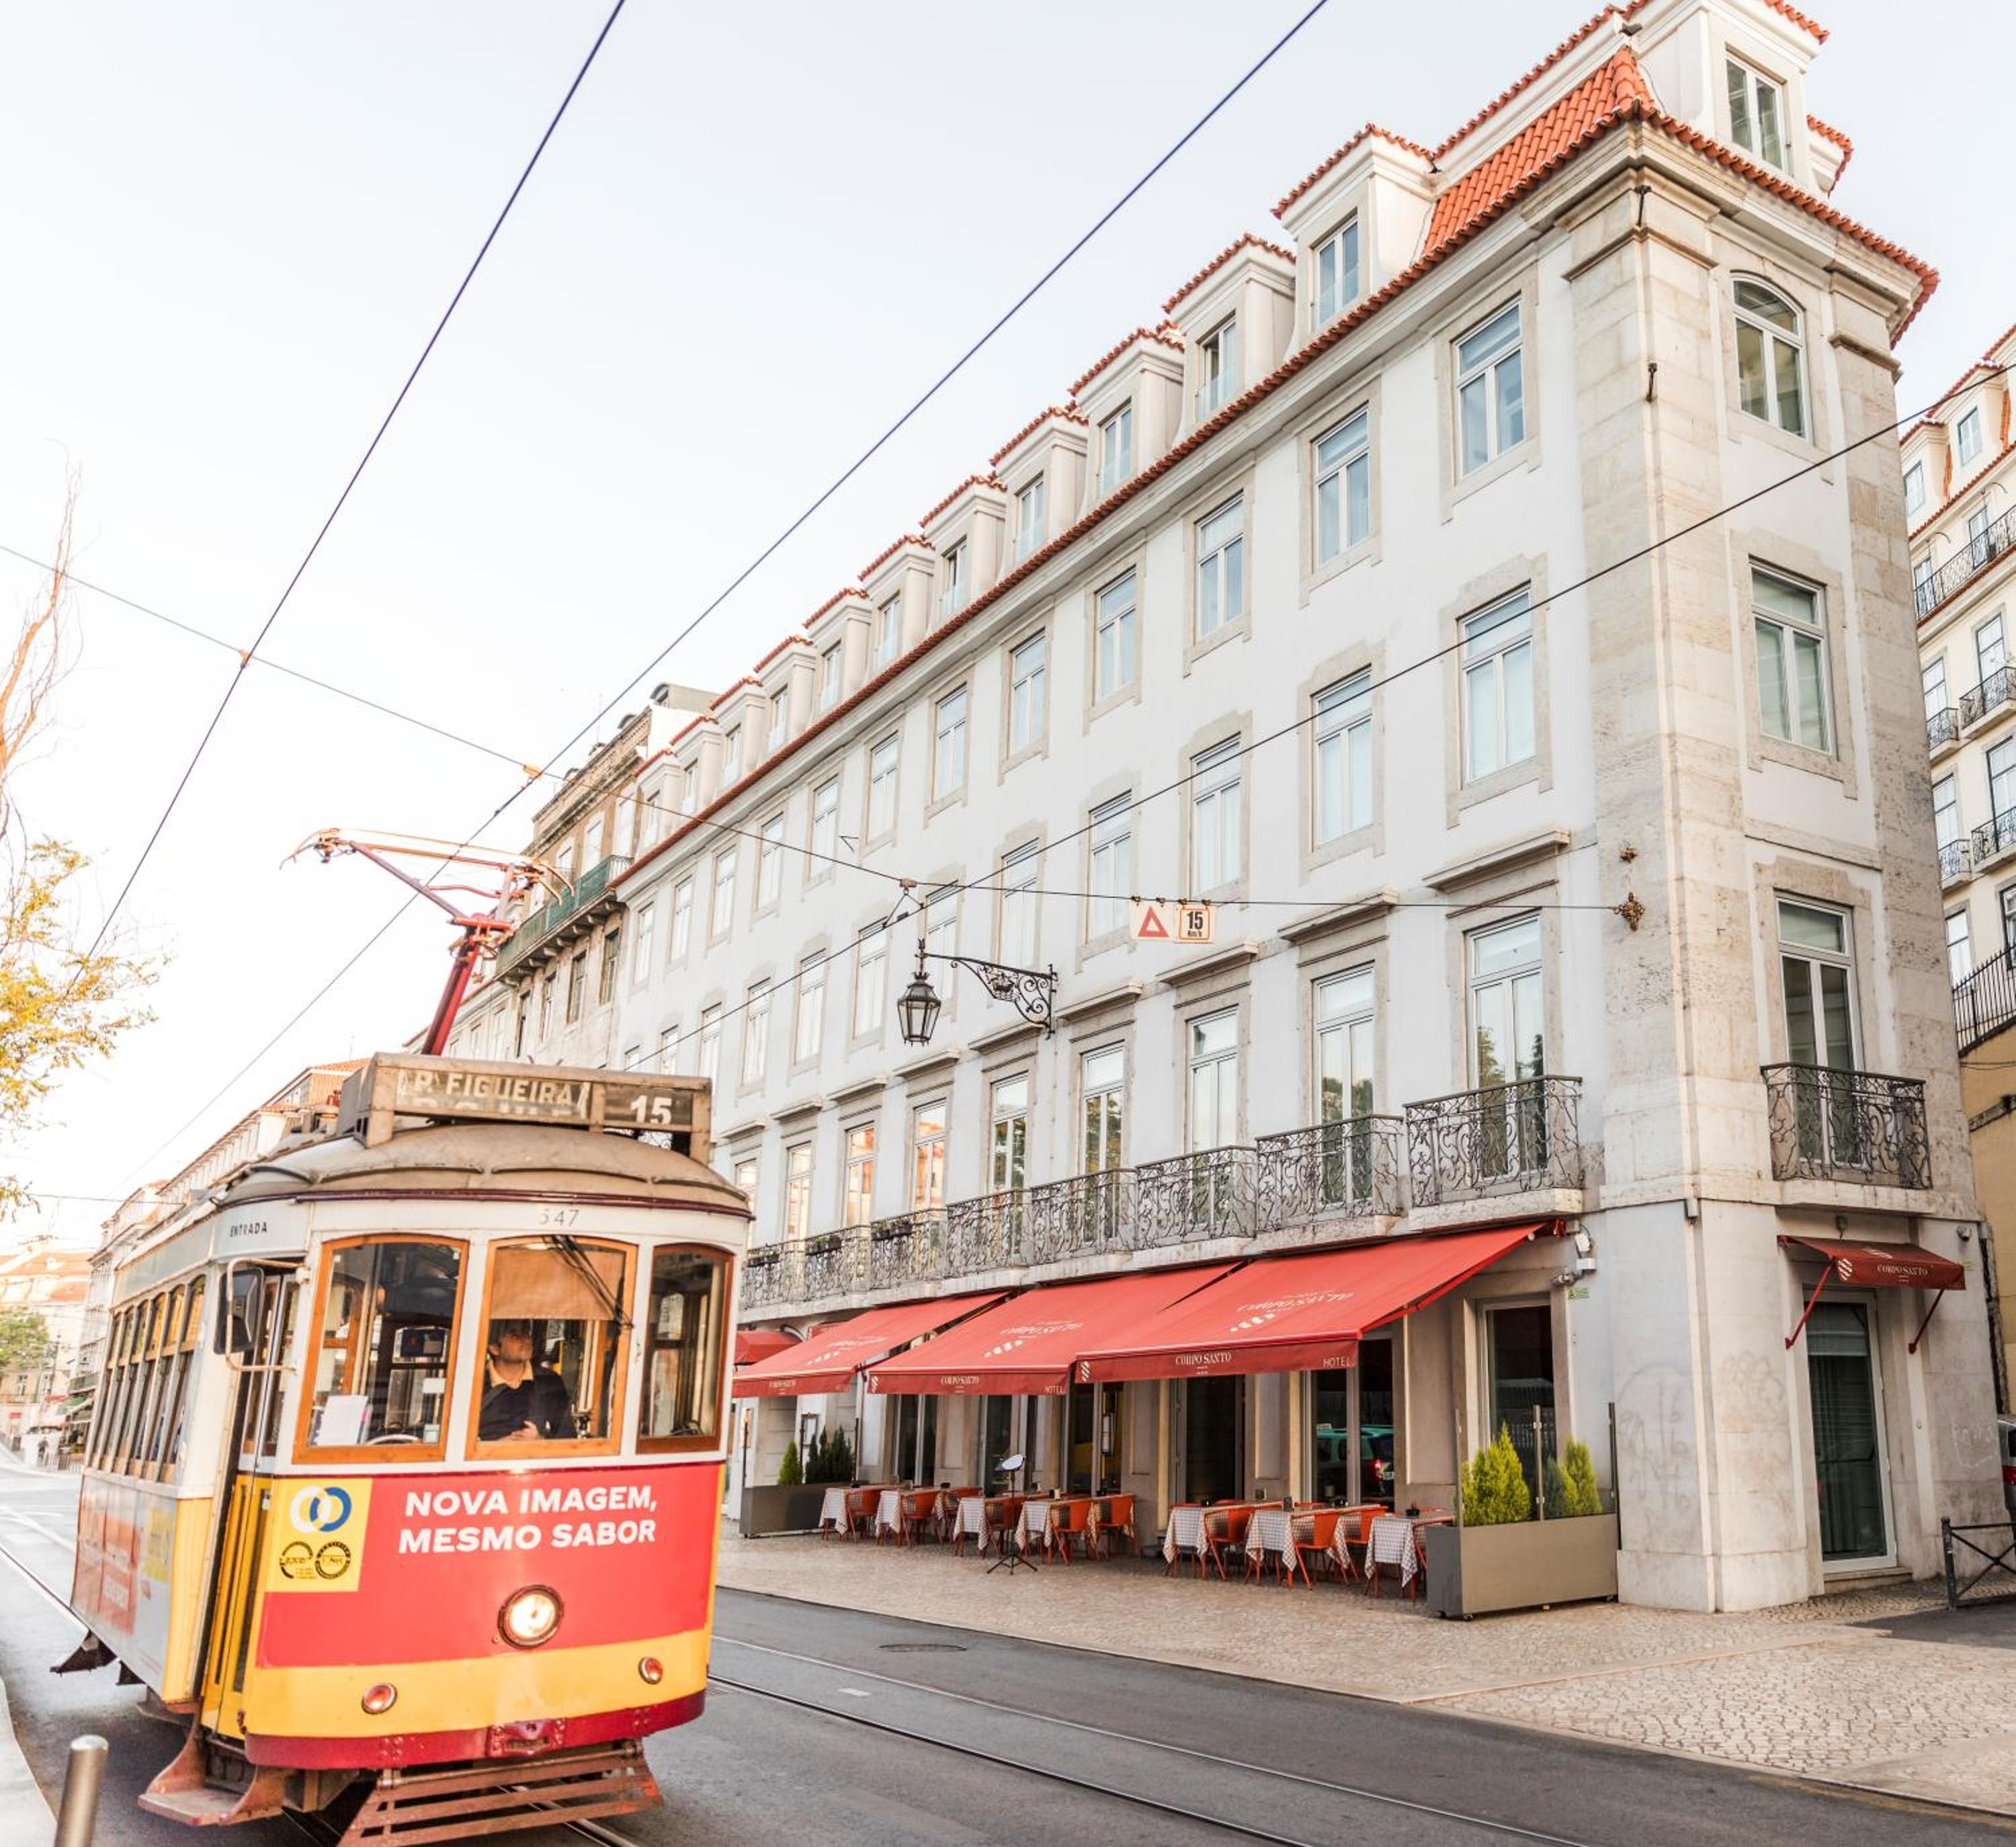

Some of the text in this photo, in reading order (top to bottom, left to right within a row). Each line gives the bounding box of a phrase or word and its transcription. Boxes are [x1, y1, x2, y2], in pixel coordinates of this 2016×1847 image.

[1187, 911, 1204, 929] 15
[446, 1073, 572, 1104] FIGUEIRA
[630, 1095, 673, 1125] 15
[1323, 1356, 1350, 1368] HOTEL
[405, 1485, 657, 1517] NOVA IMAGEM,
[398, 1520, 657, 1554] MESMO SABOR
